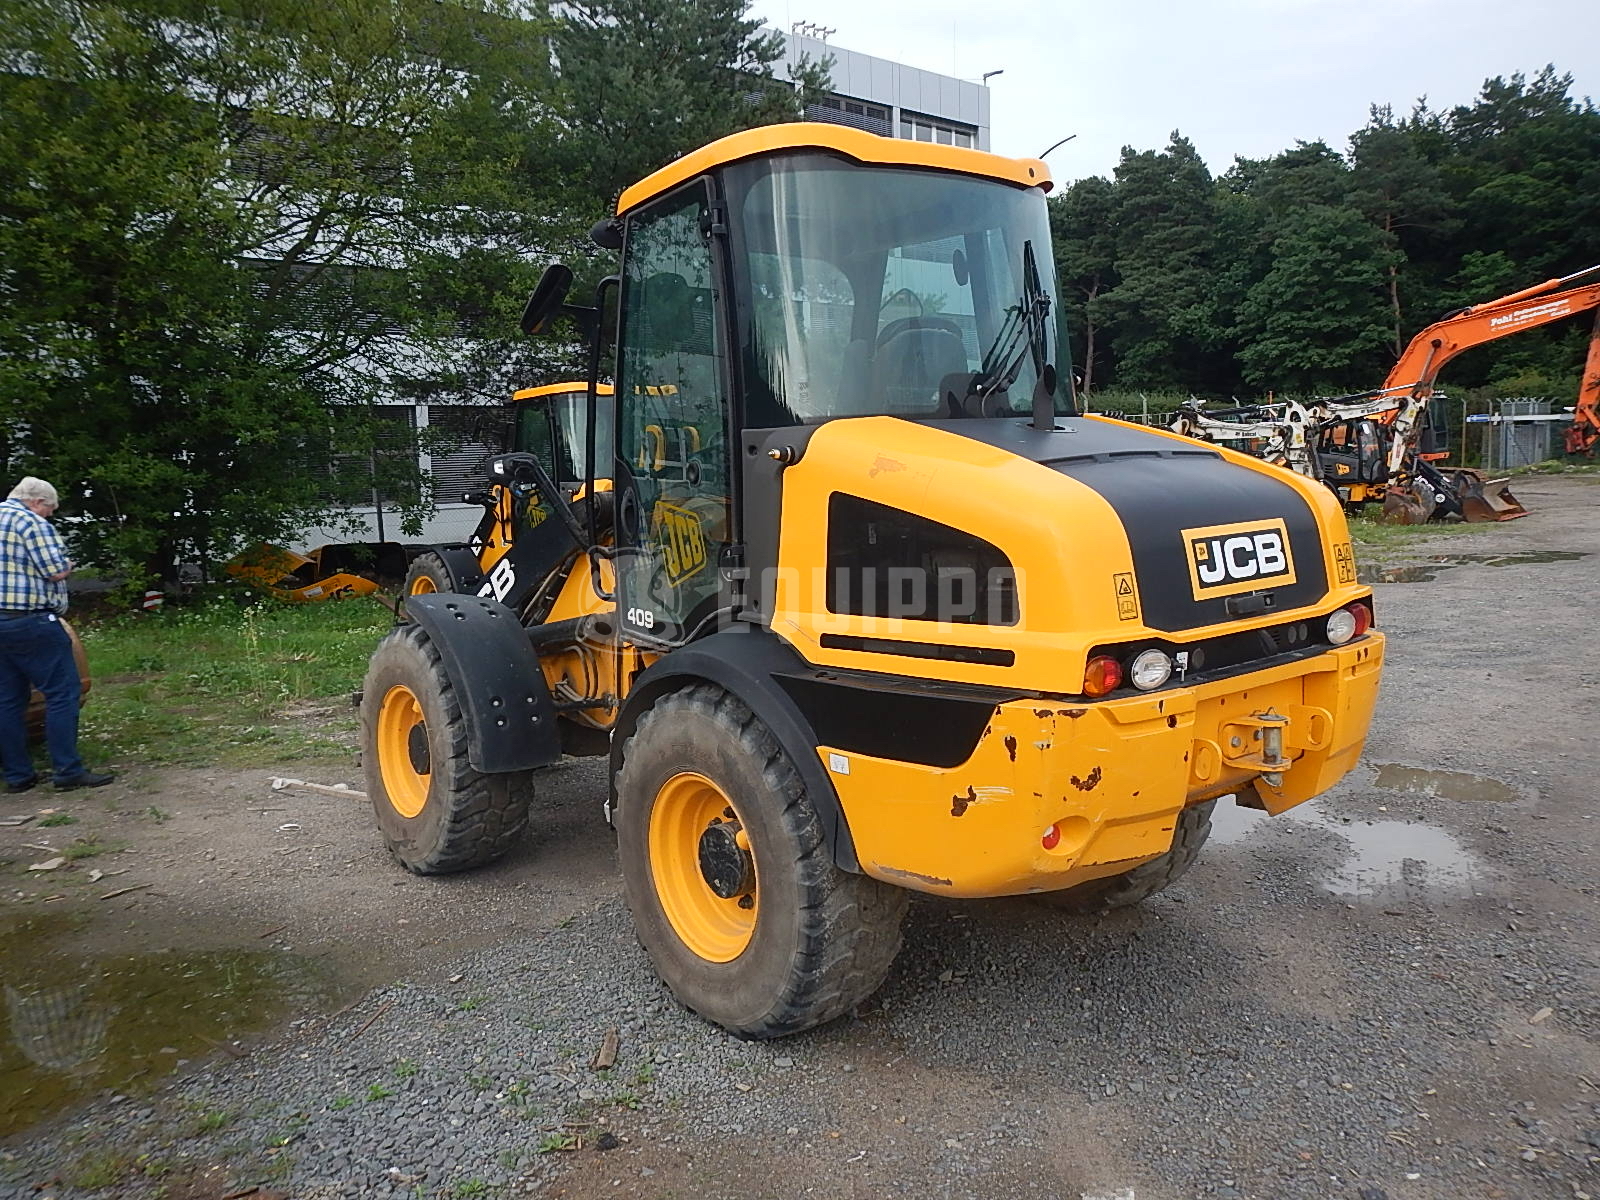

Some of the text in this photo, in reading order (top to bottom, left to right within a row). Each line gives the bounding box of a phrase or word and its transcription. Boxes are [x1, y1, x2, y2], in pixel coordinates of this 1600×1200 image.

[663, 510, 704, 577] JCB
[1198, 533, 1286, 584] JCB
[627, 607, 654, 629] 409
